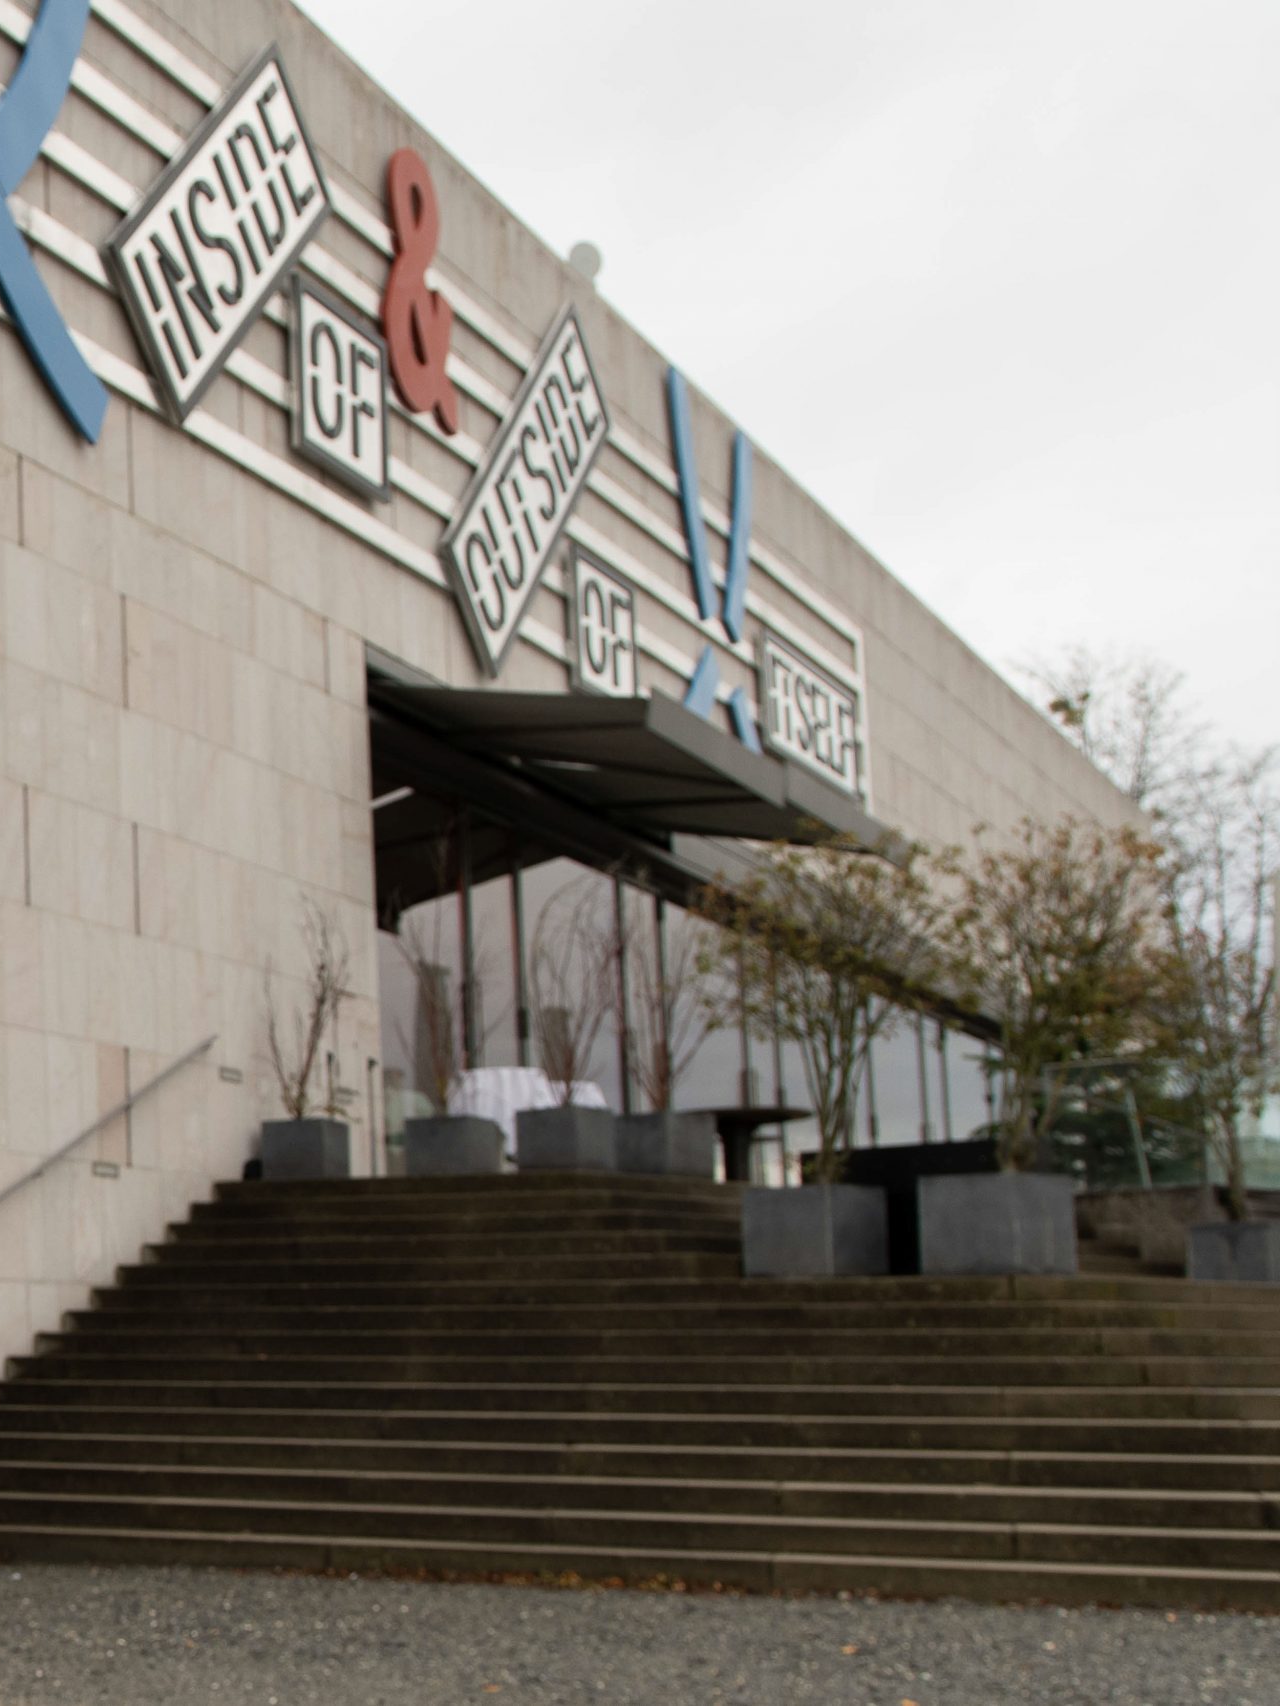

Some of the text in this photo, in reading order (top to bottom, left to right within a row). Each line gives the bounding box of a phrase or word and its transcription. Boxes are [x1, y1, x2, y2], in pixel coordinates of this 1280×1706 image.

[134, 79, 316, 381] INSIDE
[311, 322, 376, 458] OF
[382, 147, 458, 436] &
[464, 336, 601, 632] OUTSIDE
[584, 578, 631, 687] OF
